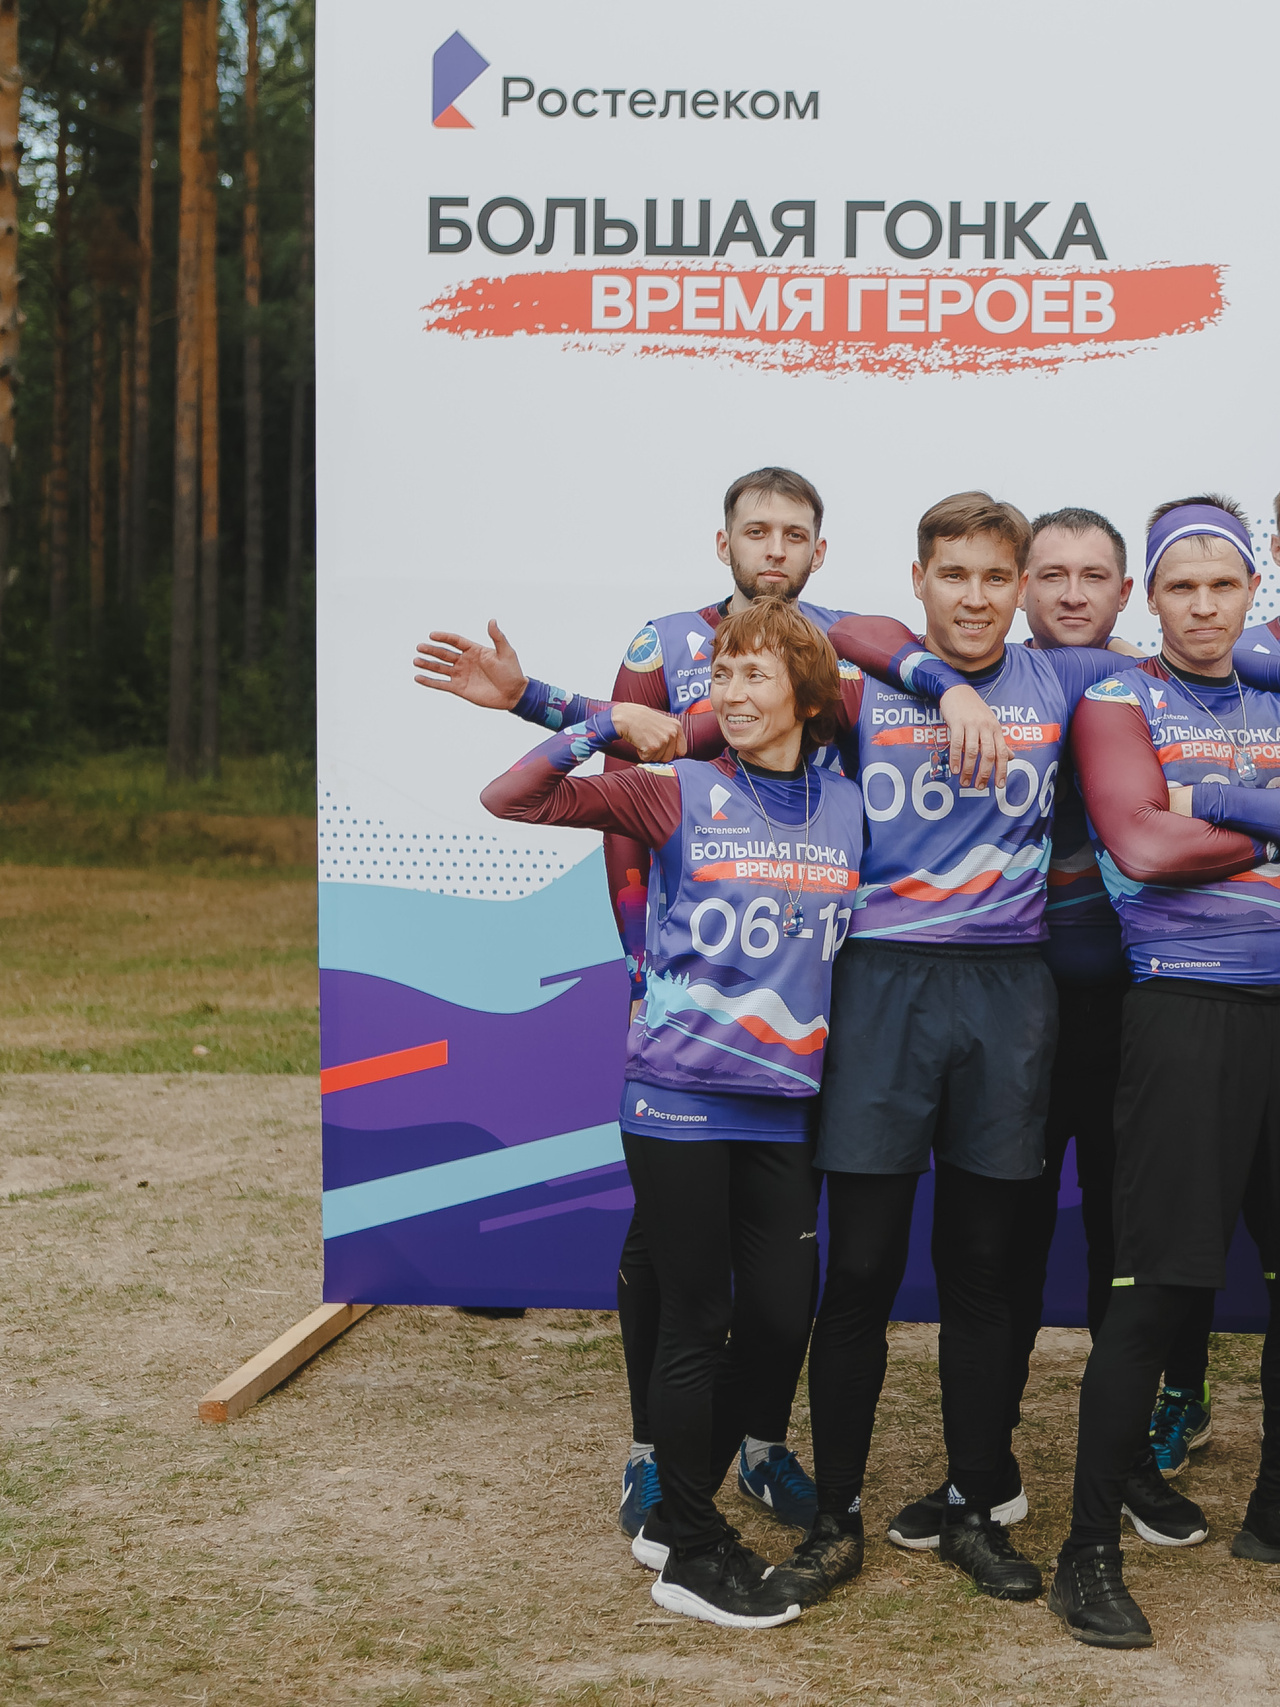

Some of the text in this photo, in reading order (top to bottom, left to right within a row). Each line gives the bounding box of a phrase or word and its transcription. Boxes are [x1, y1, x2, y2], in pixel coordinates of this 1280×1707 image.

[501, 76, 820, 121] Ростелеком
[427, 195, 1107, 261] БОЛЬШАЯ ГОНКА
[591, 275, 1115, 334] ВРЕМЯ ГЕРОЕВ
[677, 665, 711, 679] Ростел
[872, 705, 1040, 725] БОЛЬШ ОНКА
[913, 725, 1043, 743] ВРЕ РОЕВ
[1153, 726, 1226, 745] ОЛЬШАЯ
[1181, 743, 1232, 758] ВРЕМЯ
[694, 825, 750, 835] Ростелеком
[691, 840, 848, 867] БОЛЬШАЯ ГОНКА
[735, 862, 849, 887] ВРЕМЯ ГЕРОЕВ
[1162, 960, 1221, 970] Ростелеком
[647, 1108, 708, 1122] Ростелеком
